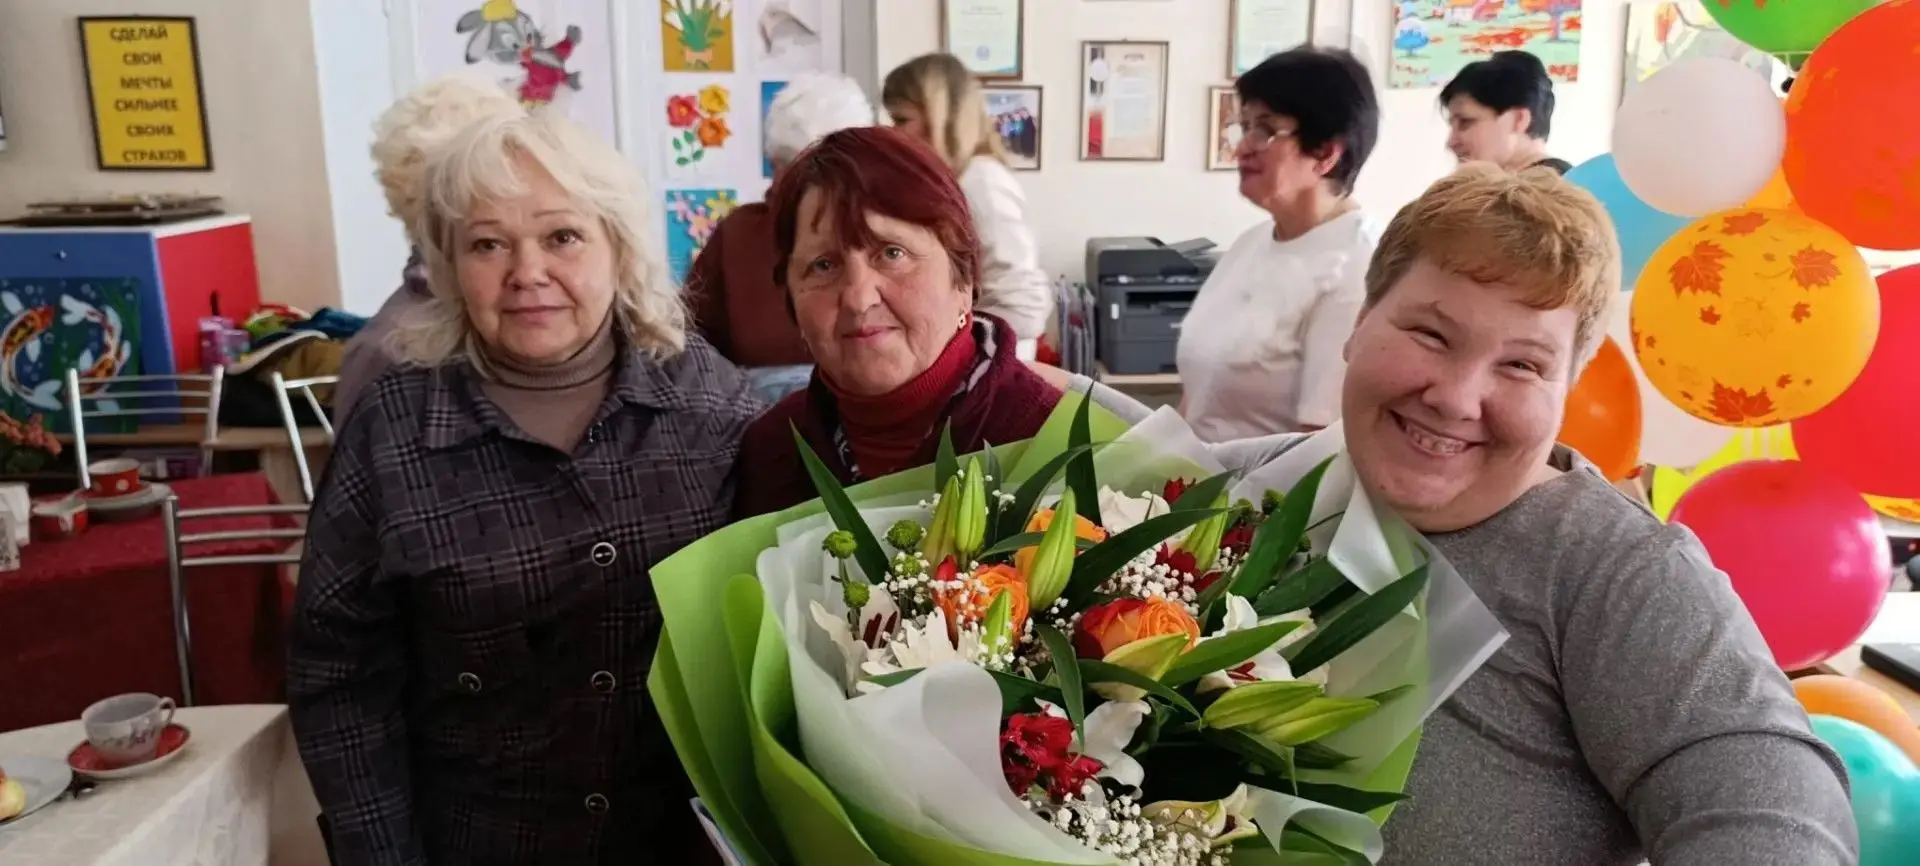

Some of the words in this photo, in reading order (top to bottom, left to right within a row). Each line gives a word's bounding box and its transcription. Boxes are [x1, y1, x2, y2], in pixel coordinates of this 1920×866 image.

[109, 25, 169, 43] СДЕЛАЙ
[122, 51, 163, 66] СВОИ
[120, 75, 173, 89] МЕЧТЫ
[114, 98, 179, 112] СИЛЬНЕЕ
[126, 123, 176, 138] СВОИХ
[122, 148, 187, 163] СТРАХОВ
